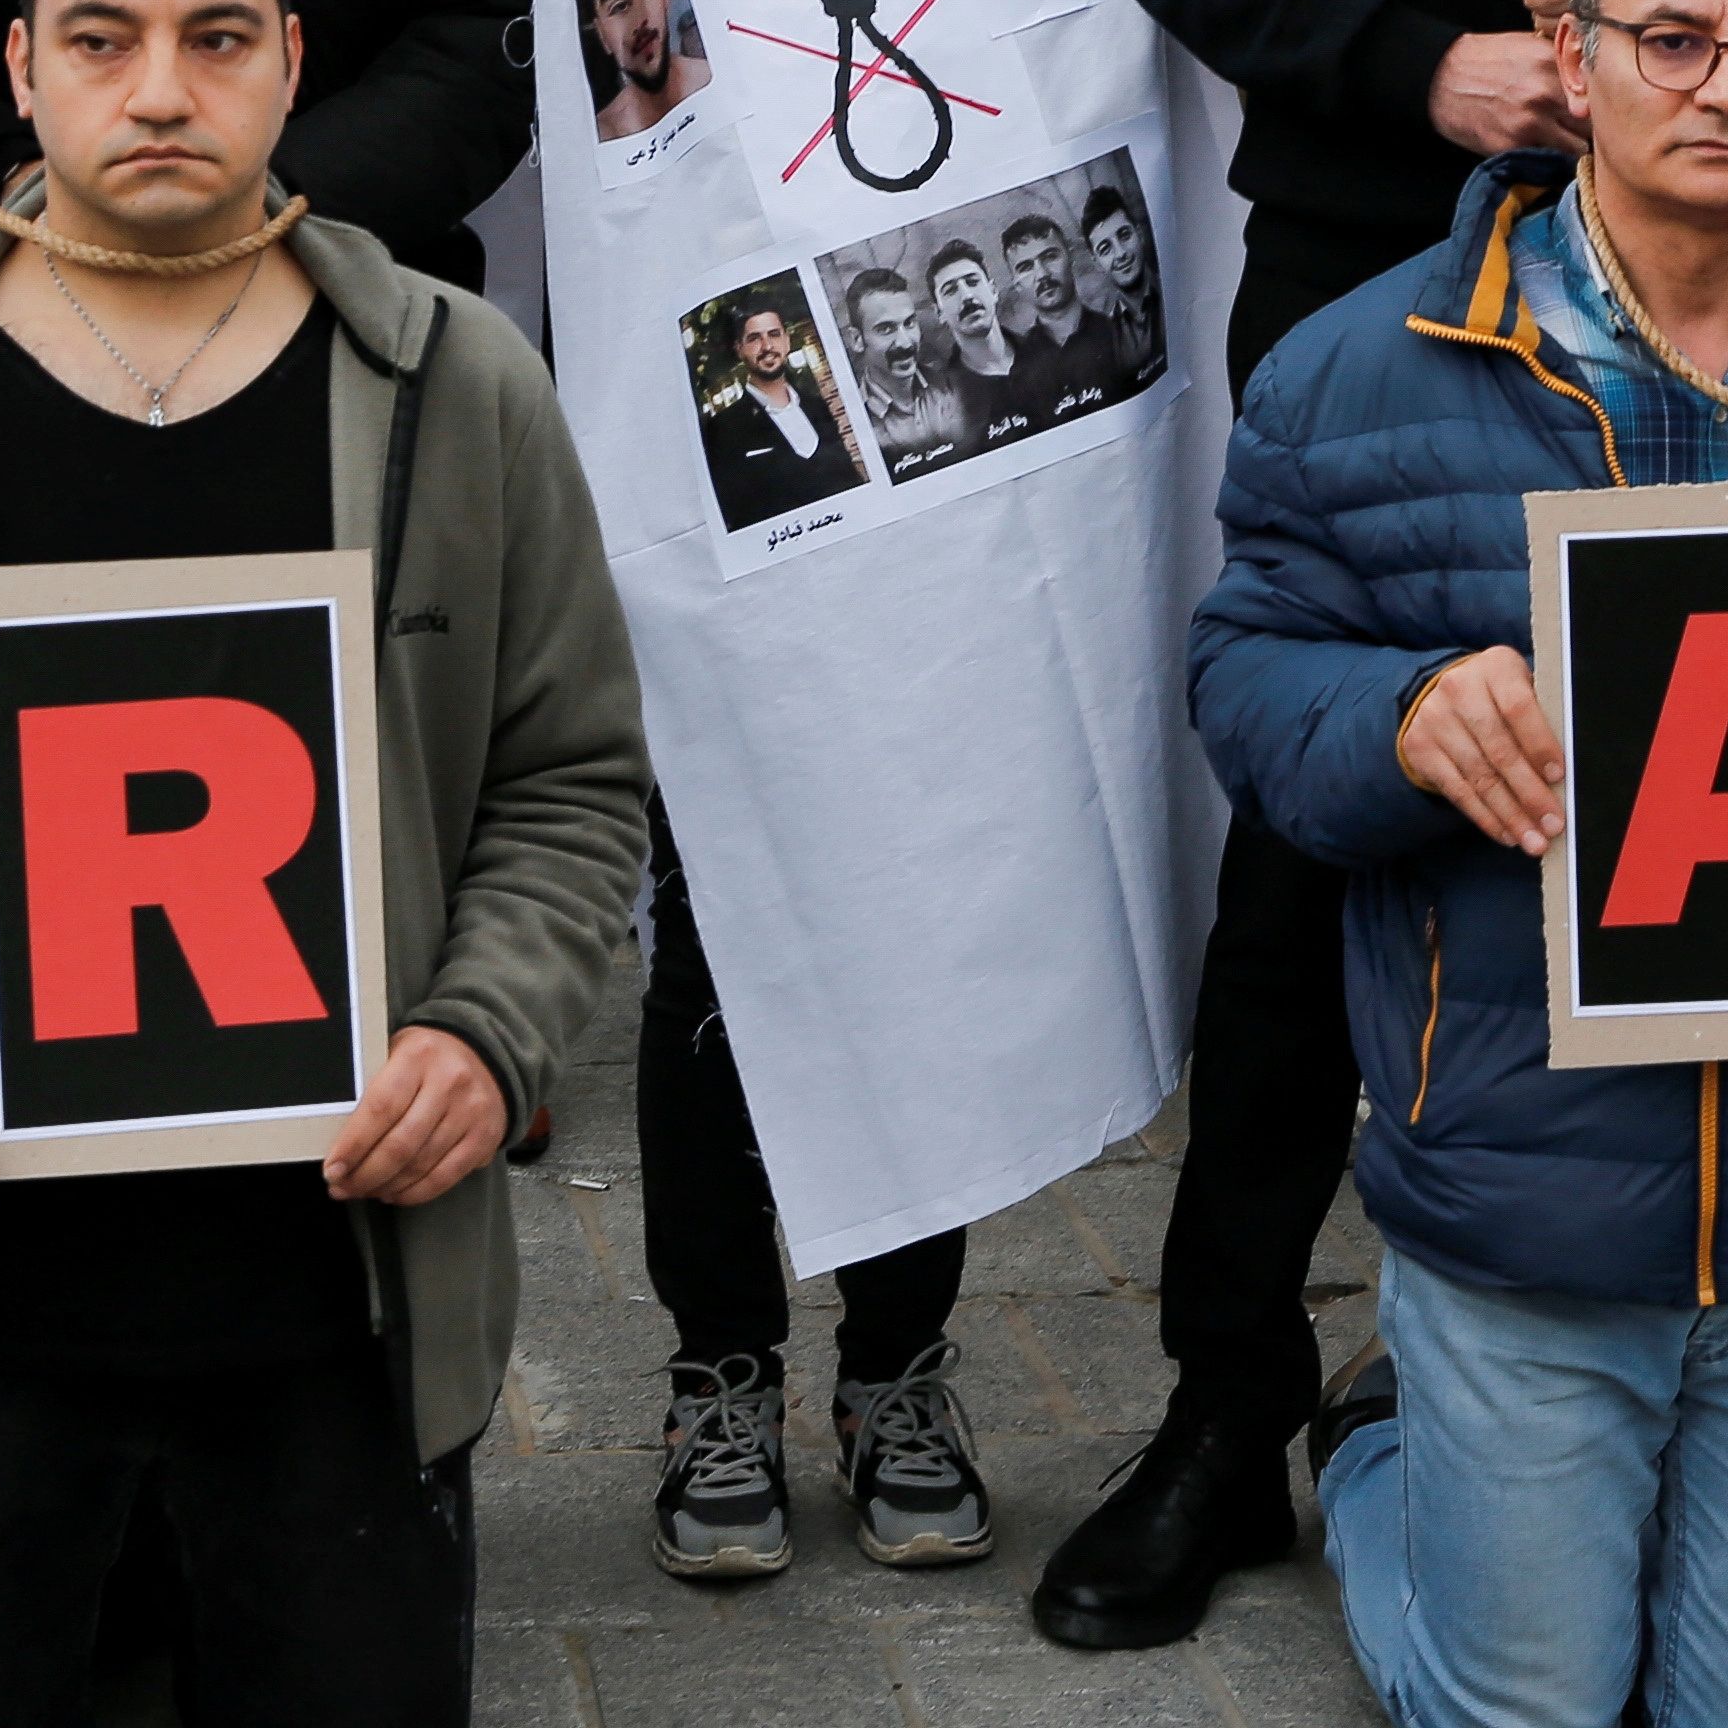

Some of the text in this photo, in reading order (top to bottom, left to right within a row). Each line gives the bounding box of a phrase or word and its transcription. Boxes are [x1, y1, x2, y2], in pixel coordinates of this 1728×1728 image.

[768, 513, 843, 552] محمد قبادلو
[17, 696, 329, 1041] R
